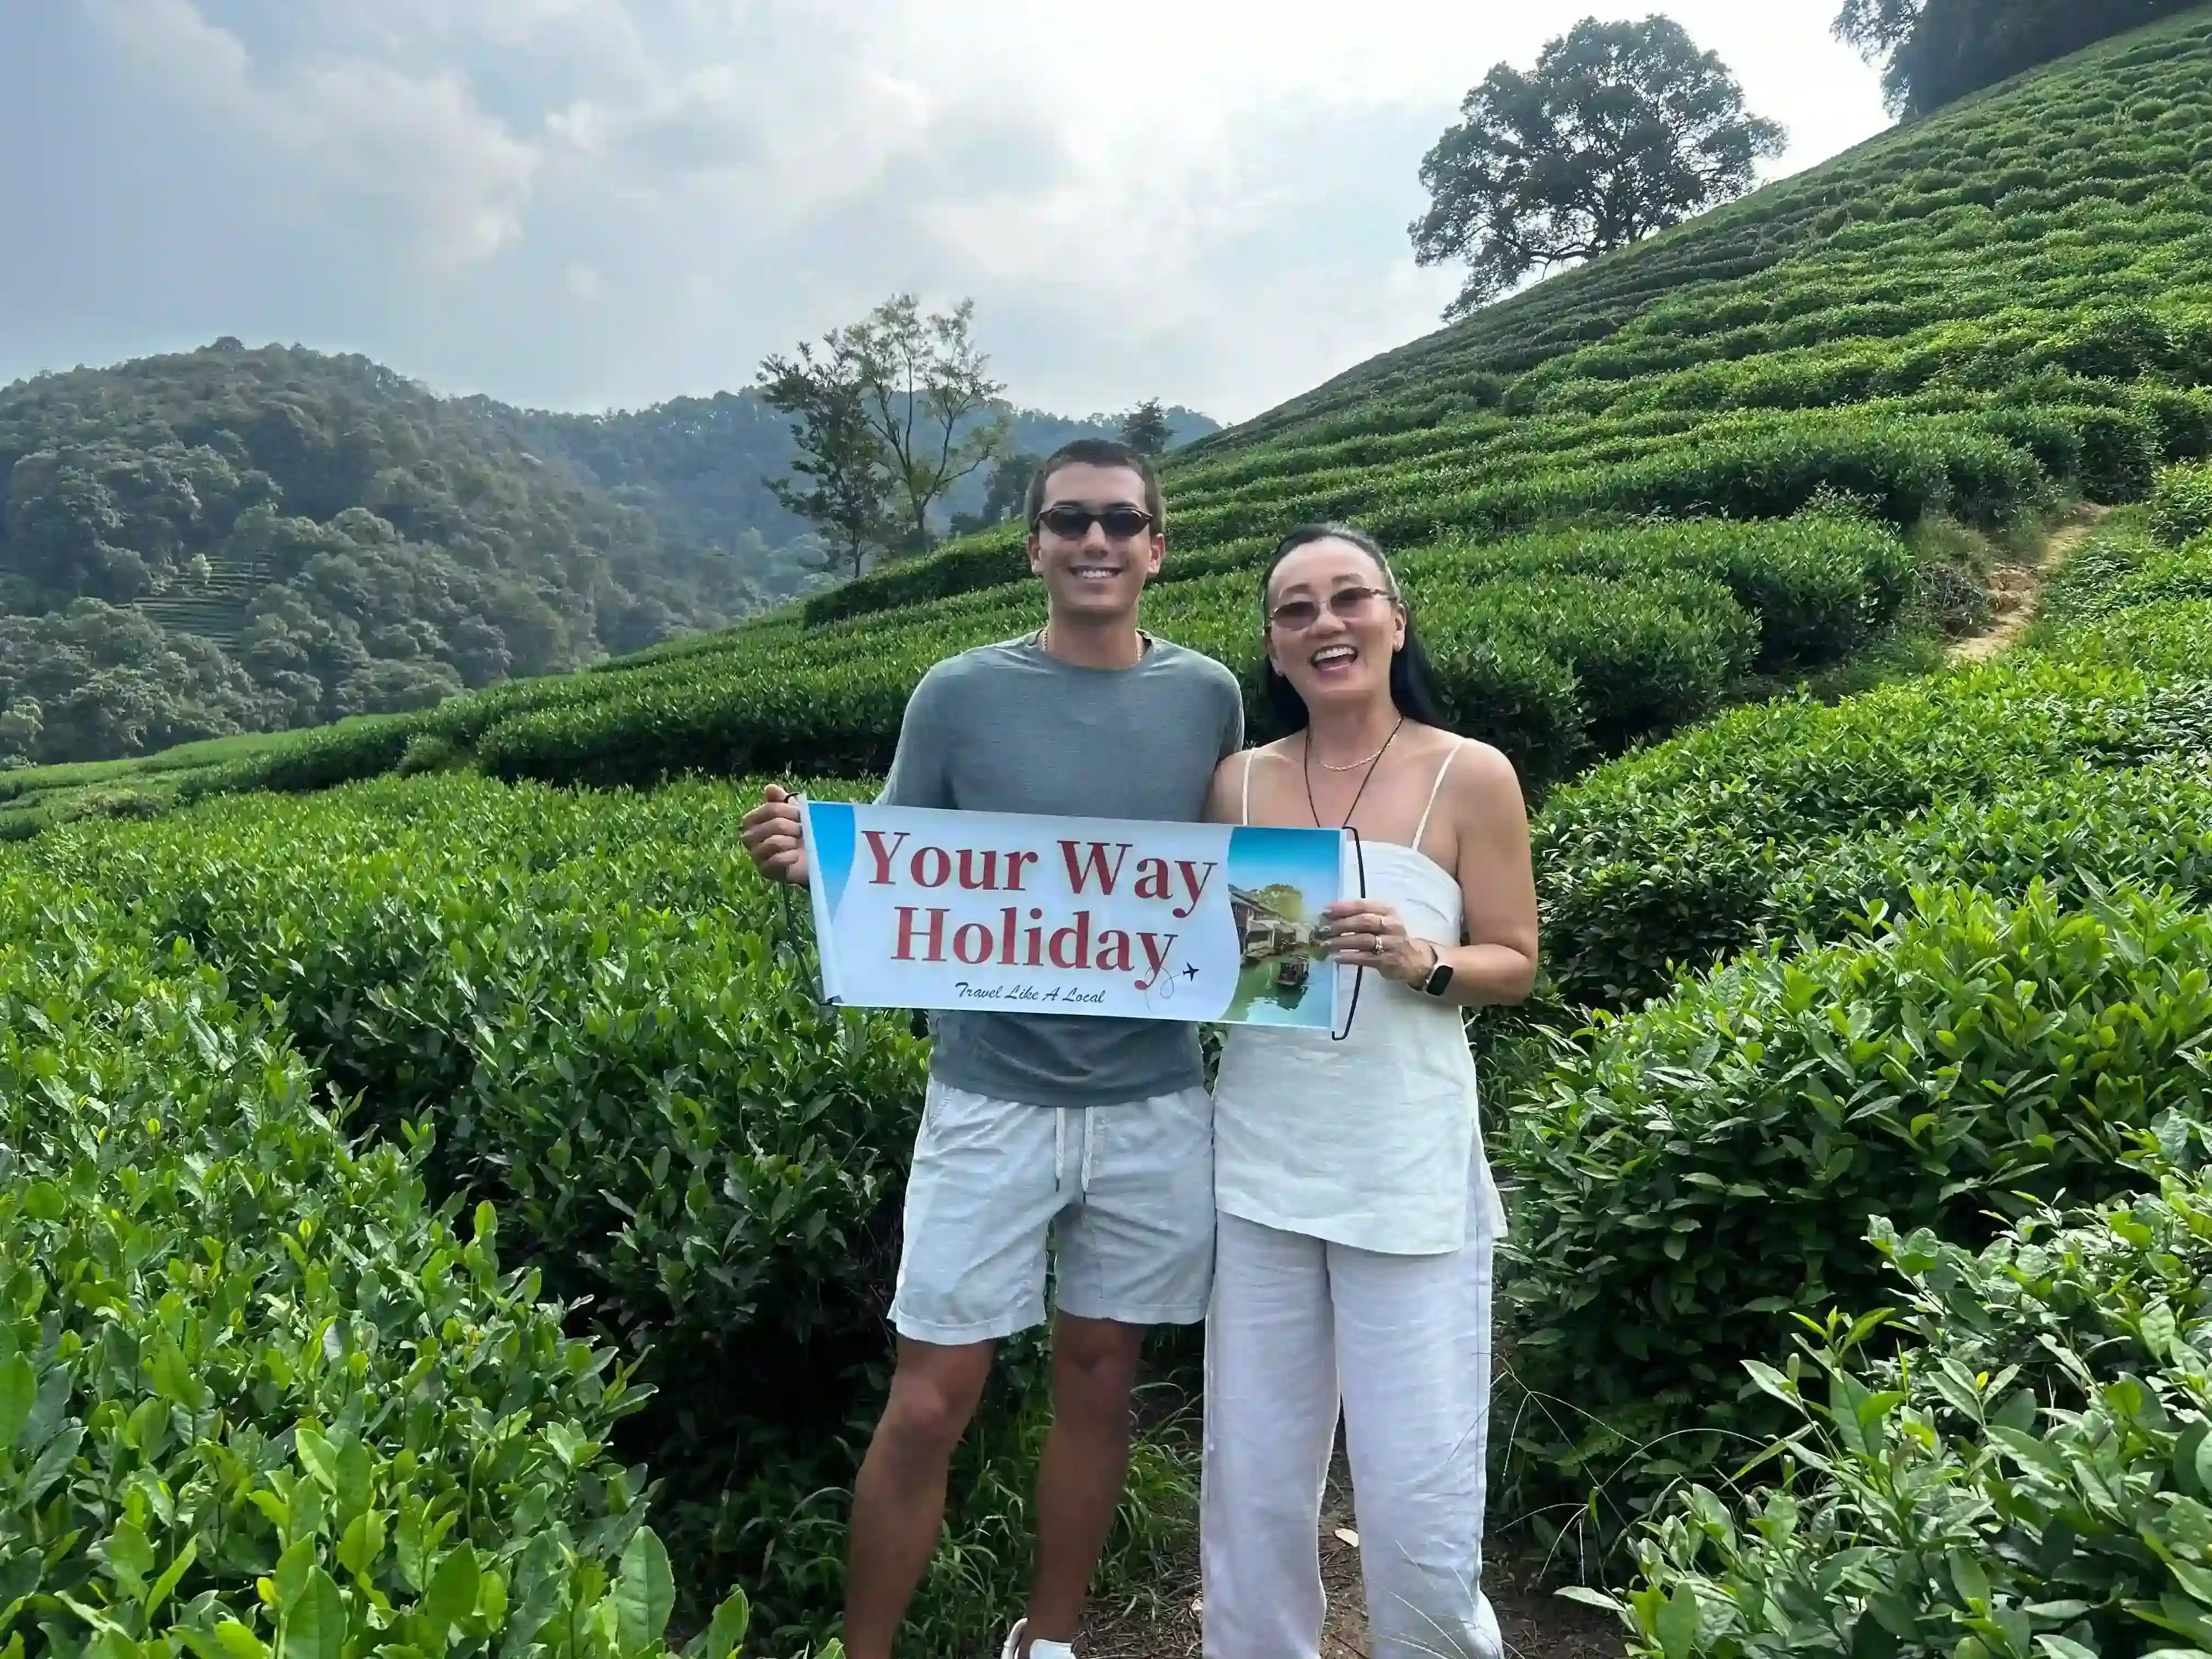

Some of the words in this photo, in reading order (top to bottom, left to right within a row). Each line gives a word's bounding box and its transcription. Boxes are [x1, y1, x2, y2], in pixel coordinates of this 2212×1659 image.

[861, 830, 1038, 891] Your
[1057, 840, 1217, 918] Way
[890, 906, 1178, 990] Holiday
[955, 981, 1002, 999] Travel
[1004, 985, 1039, 1000] Like
[1042, 986, 1061, 1001] A
[1062, 988, 1105, 1003] Local
